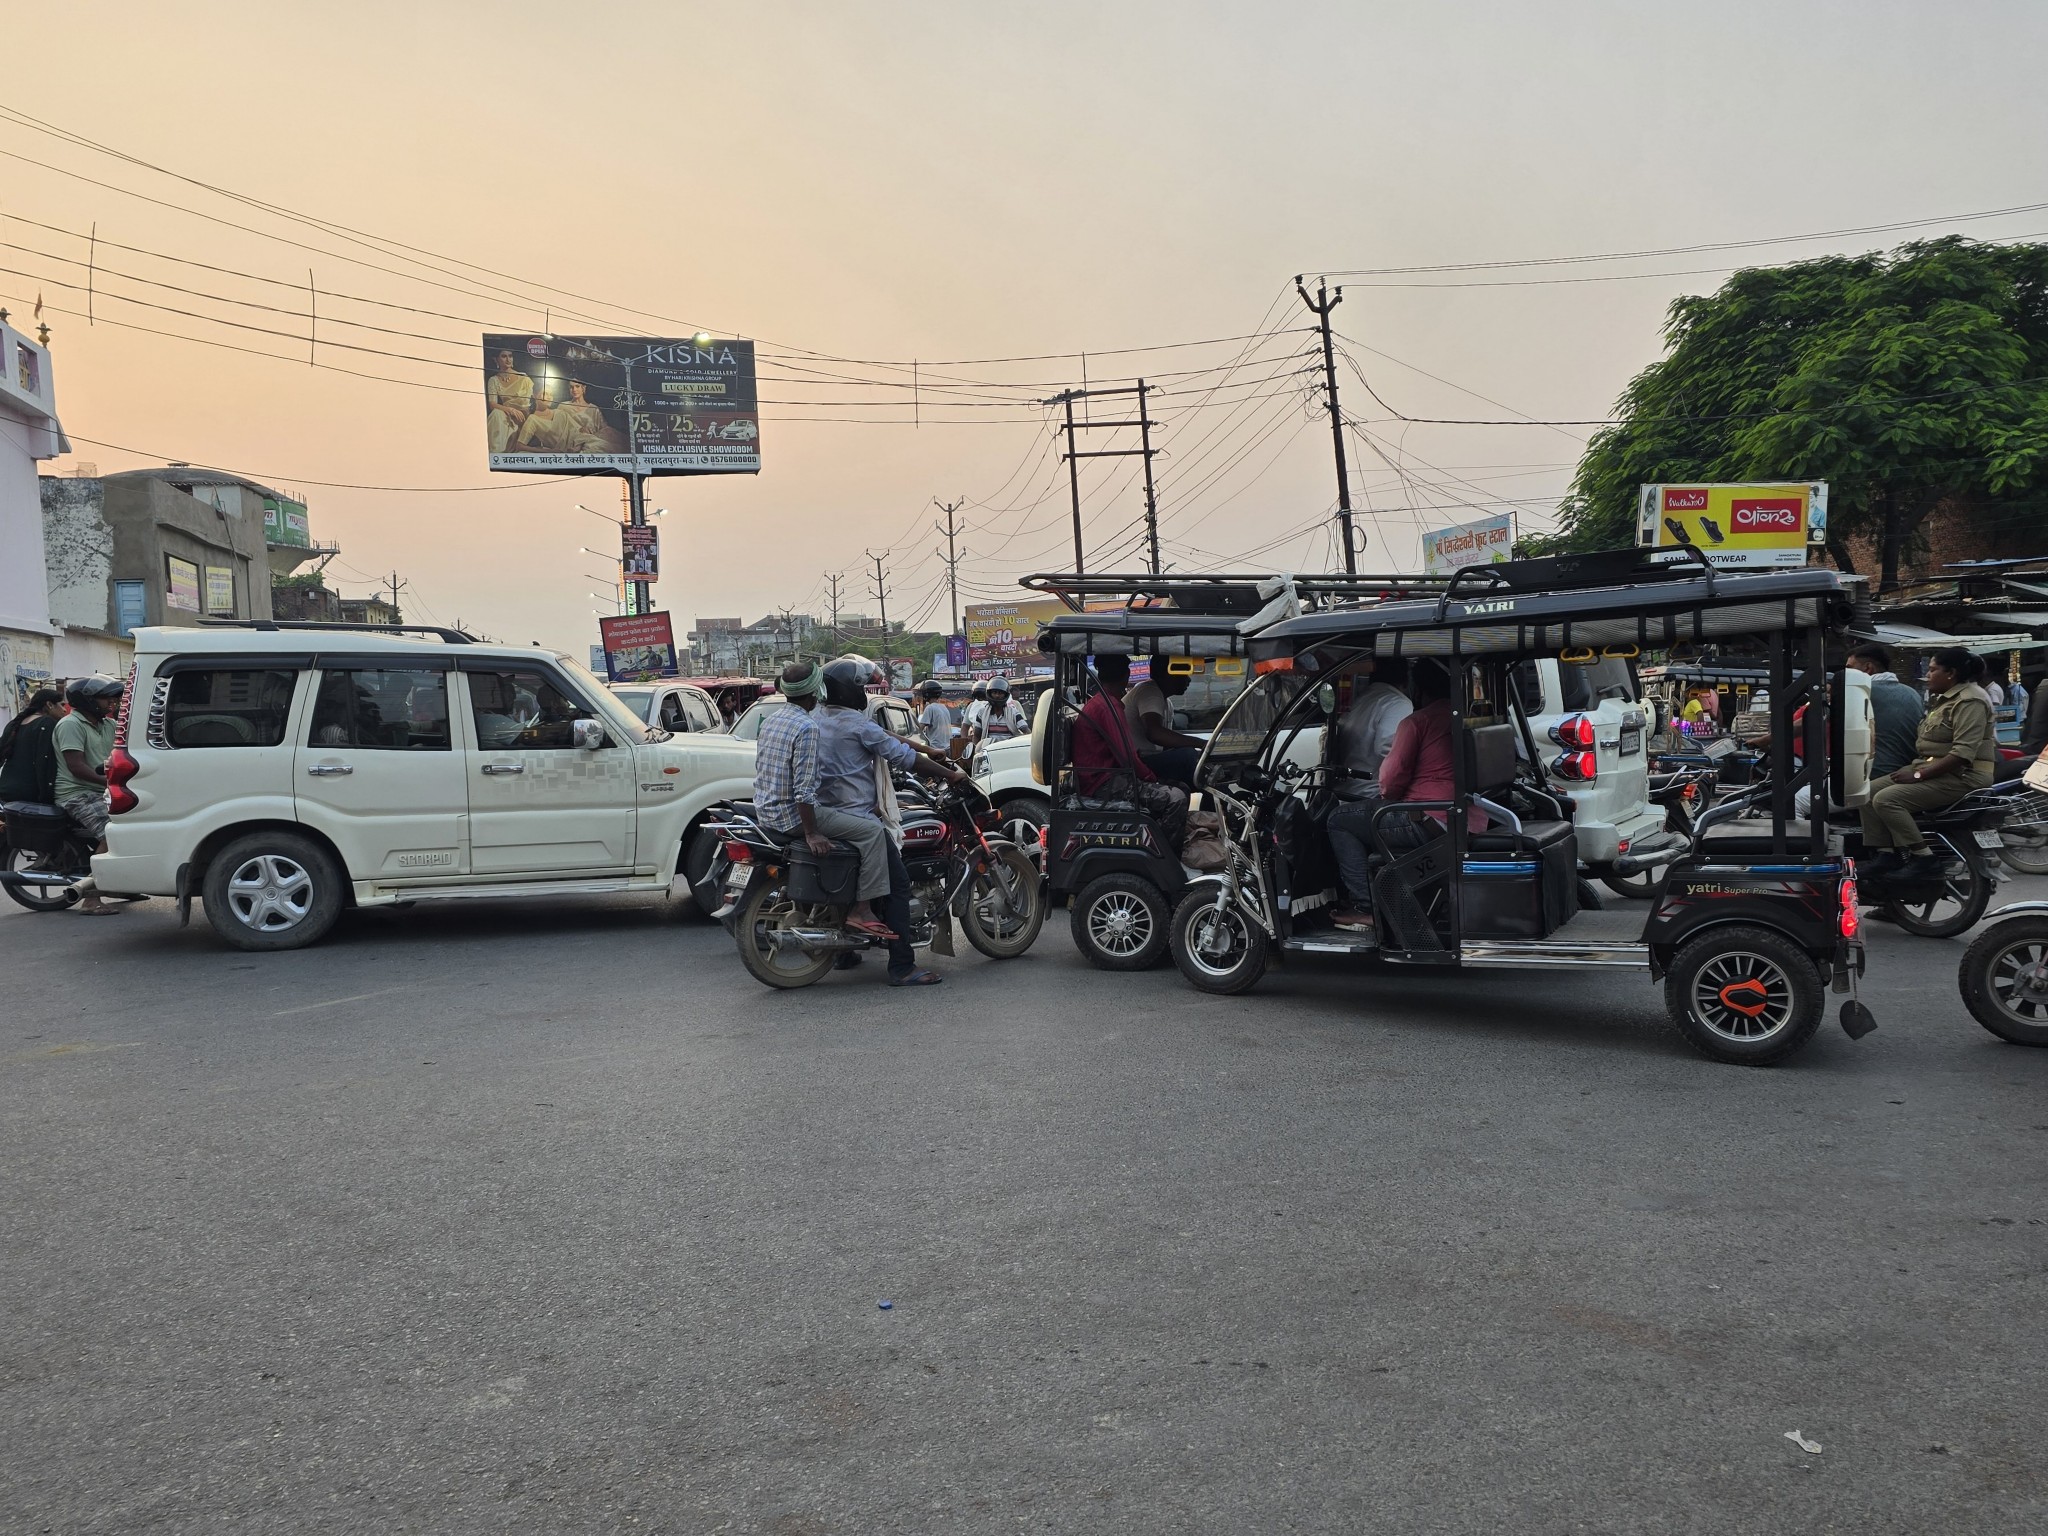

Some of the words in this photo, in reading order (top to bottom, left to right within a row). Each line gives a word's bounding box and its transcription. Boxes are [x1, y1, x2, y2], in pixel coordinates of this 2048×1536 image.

[647, 345, 737, 364] KISNA
[665, 384, 695, 392] LUCKY
[697, 384, 724, 392] DRAW
[671, 413, 694, 433] 25
[643, 445, 666, 453] KISNA
[668, 445, 708, 453] EXCLUSIVE
[709, 445, 753, 454] SHOWROOM
[608, 454, 614, 464] के
[1463, 600, 1515, 615] YATRI
[1003, 615, 1015, 625] 10
[997, 629, 1013, 644] 10
[1082, 835, 1140, 846] YATRI
[399, 852, 452, 867] SCORPIO
[1686, 882, 1721, 895] yatri
[1723, 886, 1750, 895] Super
[1752, 887, 1768, 895] Pro
